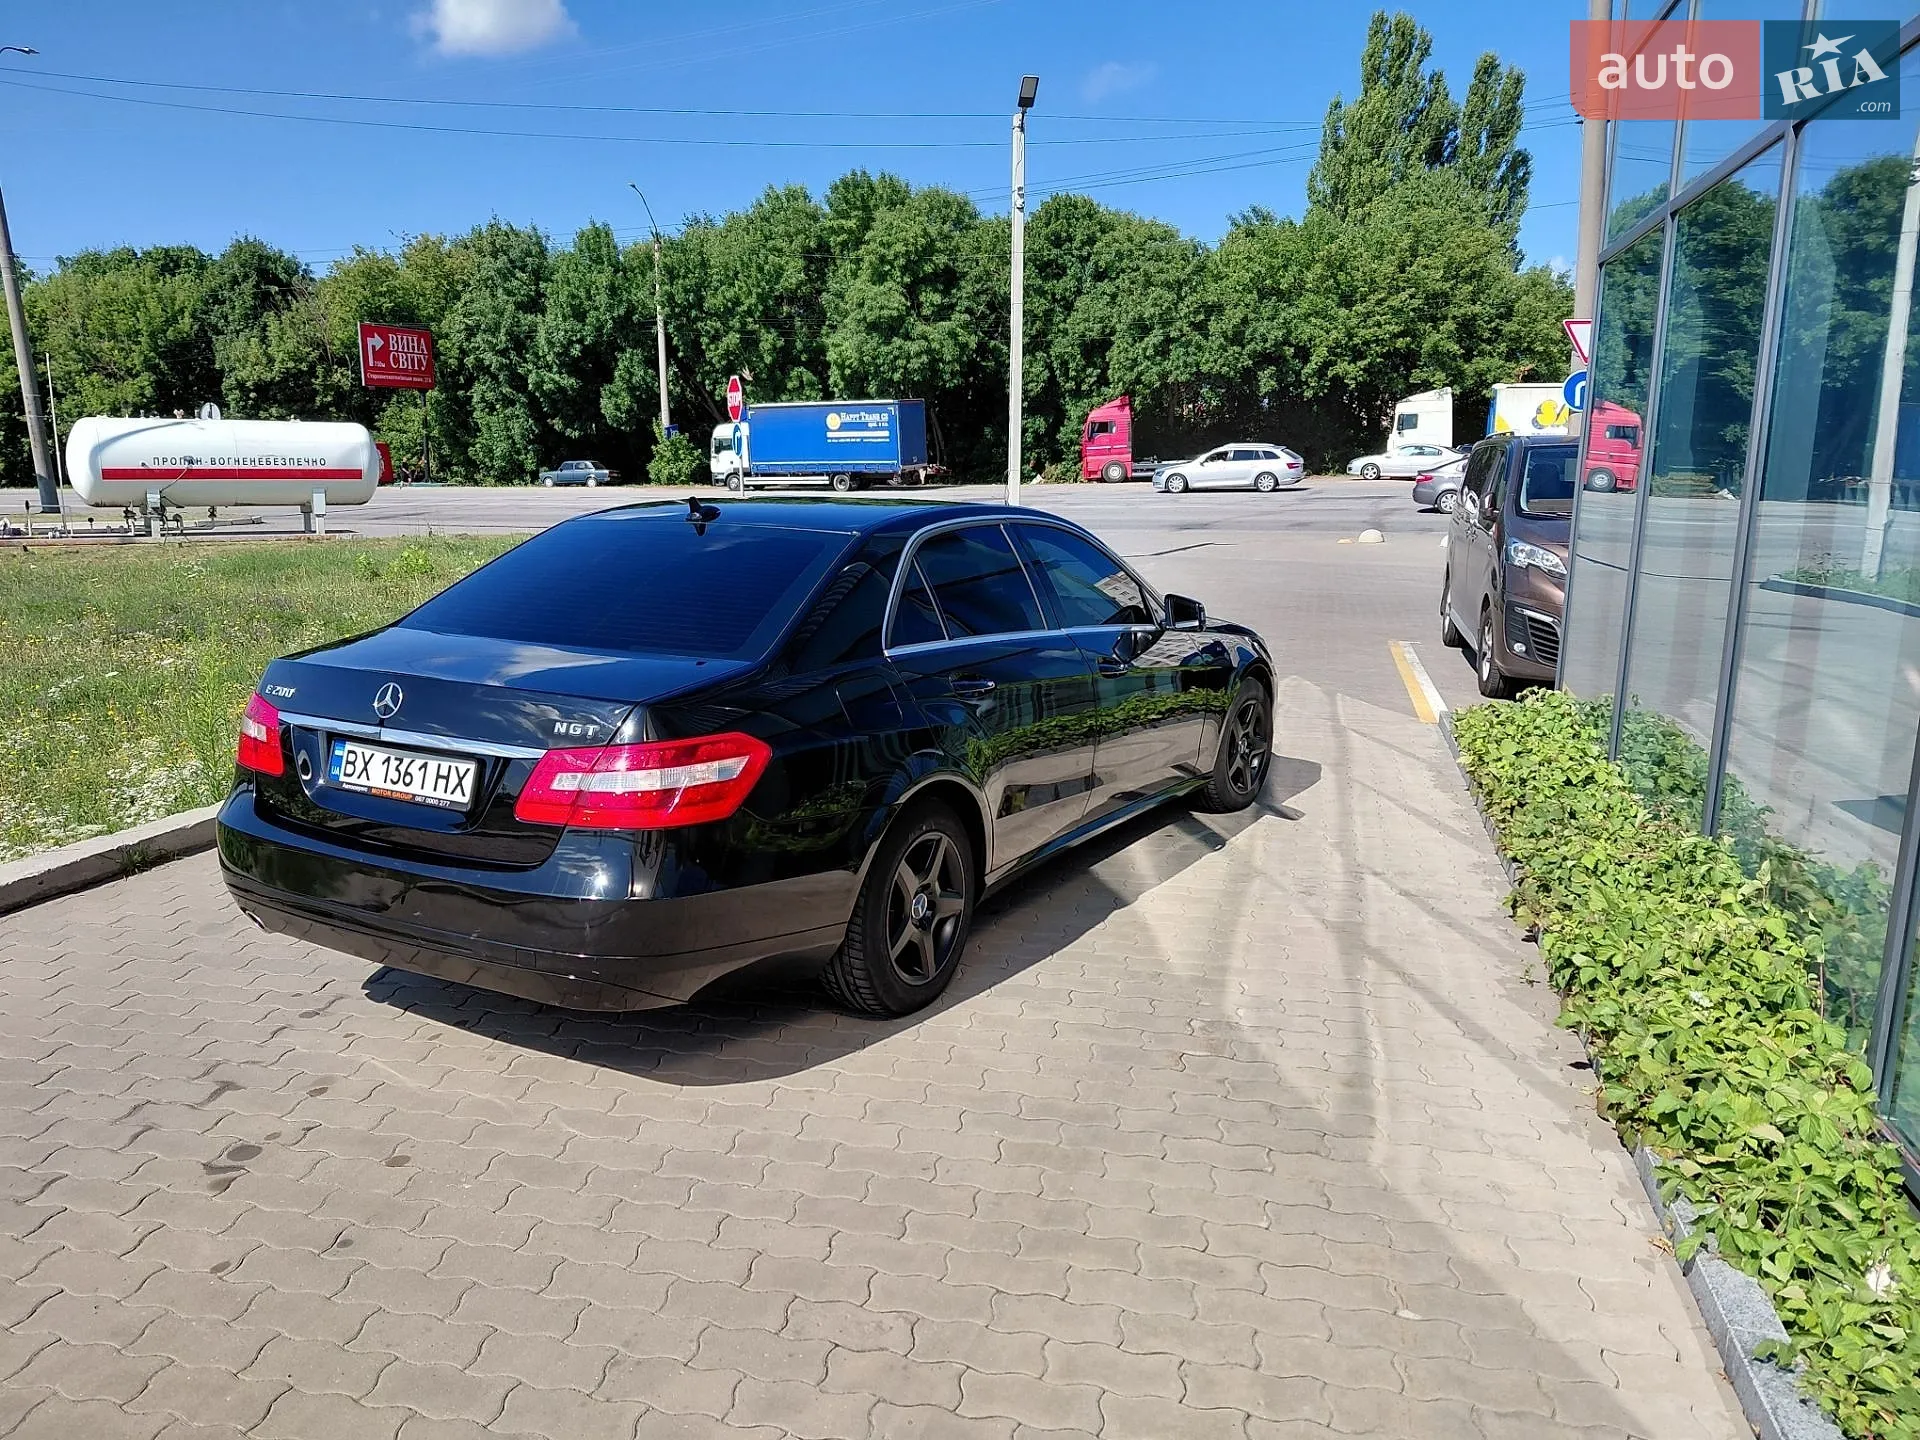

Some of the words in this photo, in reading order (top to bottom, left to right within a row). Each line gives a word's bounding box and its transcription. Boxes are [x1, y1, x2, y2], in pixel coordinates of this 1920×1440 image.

[388, 333, 428, 354] ВИНА
[389, 352, 429, 371] СВІТУ
[728, 391, 742, 407] STOP
[553, 721, 601, 738] NGT
[331, 765, 340, 776] UA
[381, 755, 429, 790] 1361
[371, 787, 391, 797] MOTOR
[392, 791, 413, 800] GROUP
